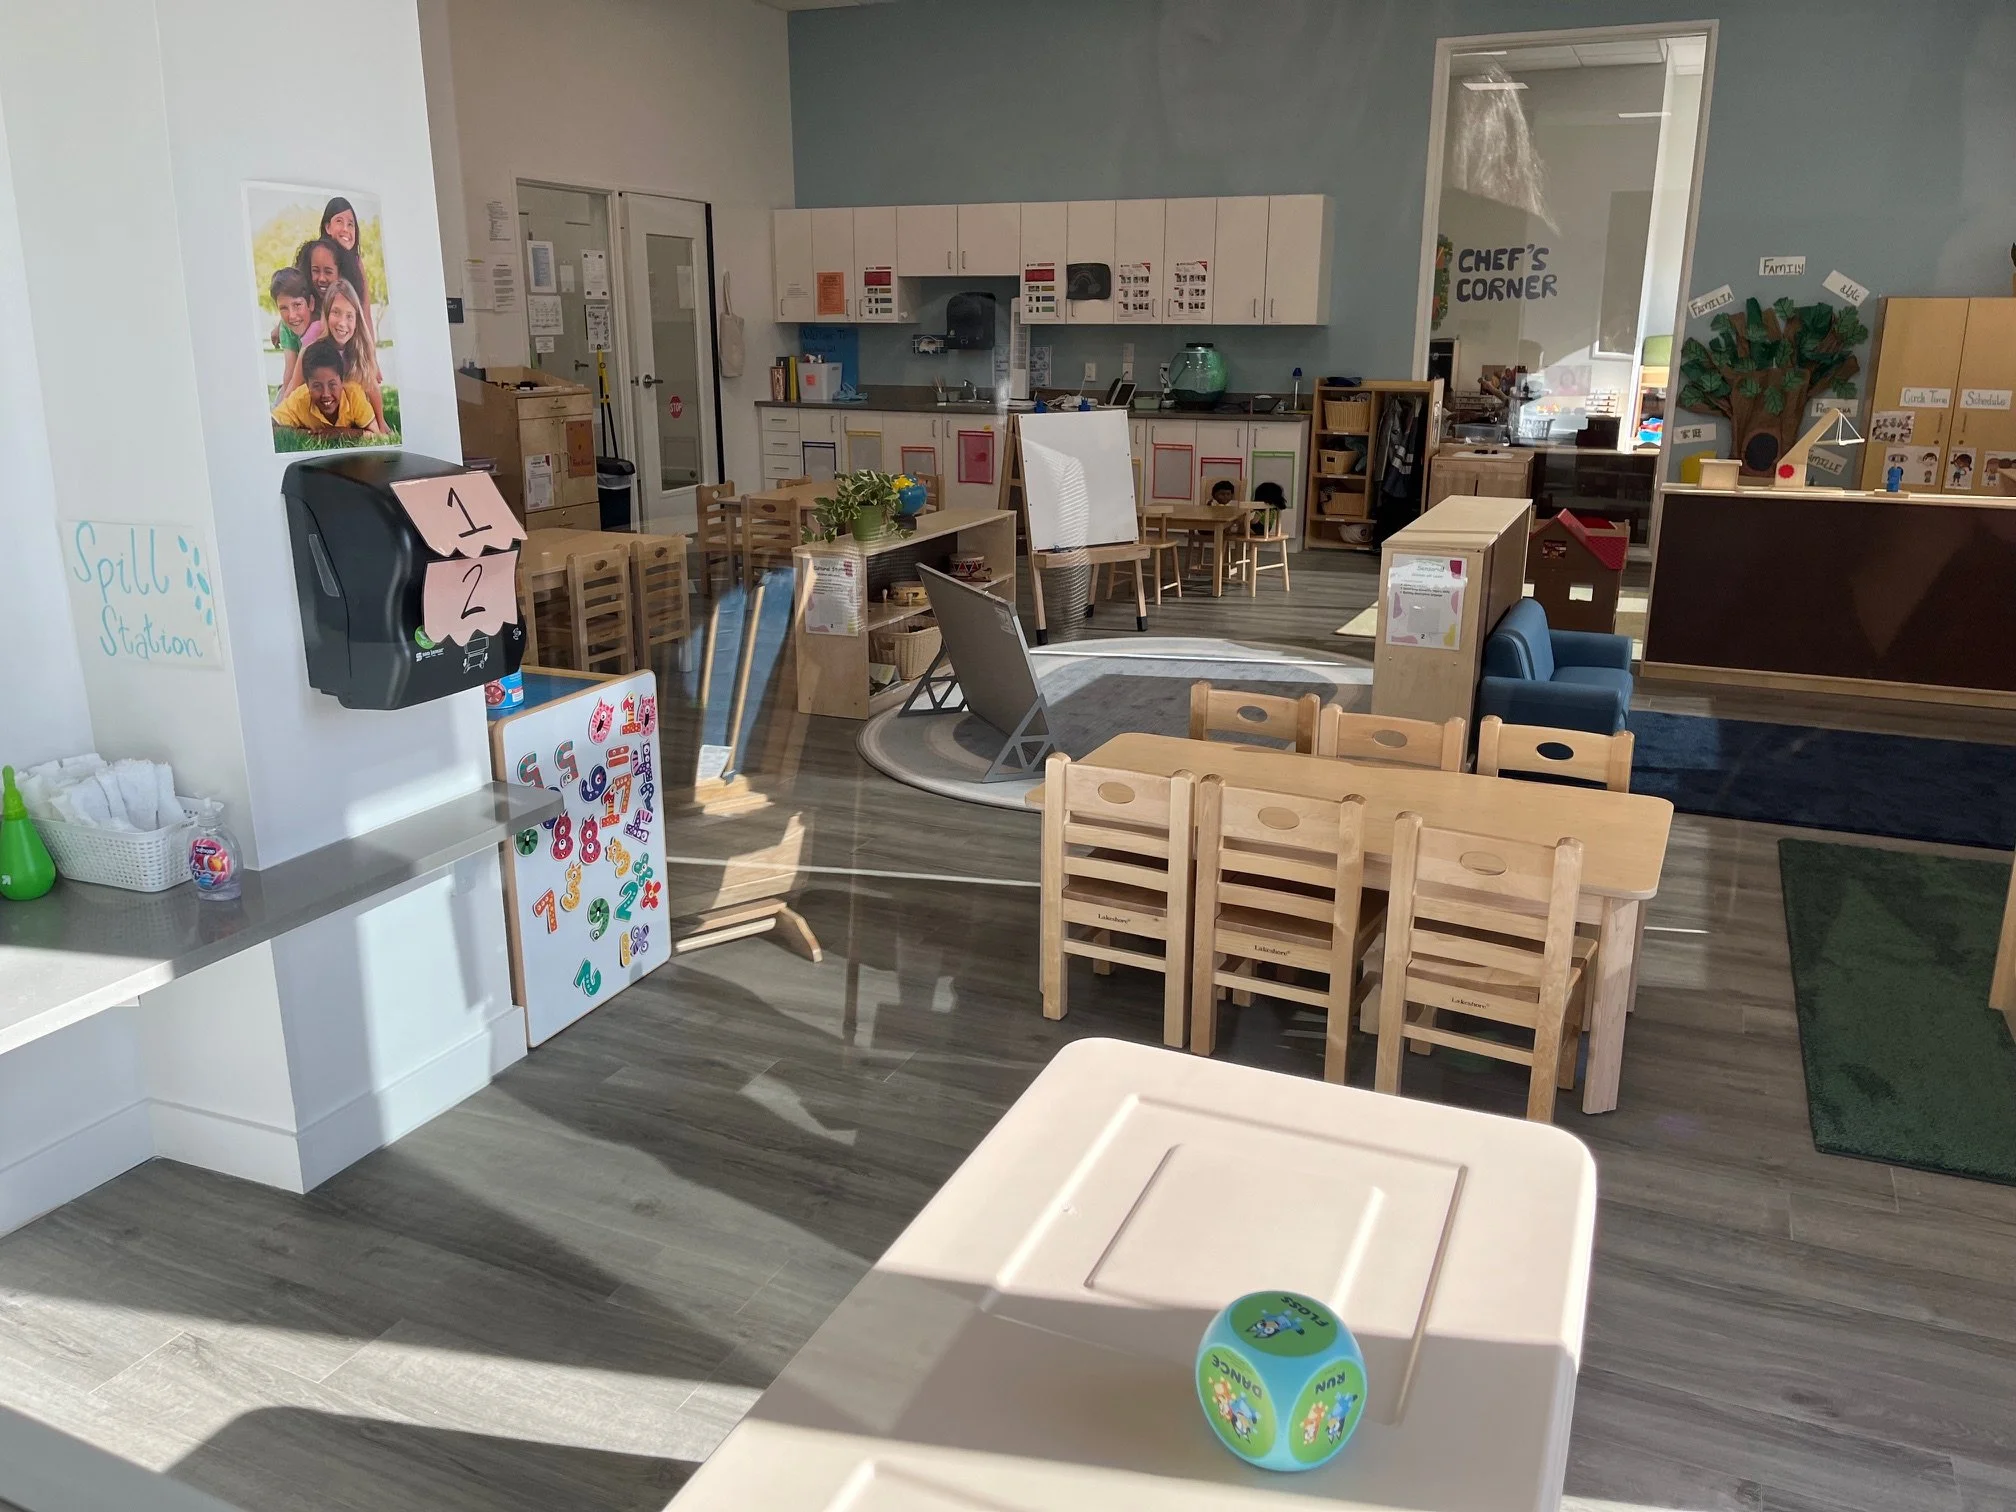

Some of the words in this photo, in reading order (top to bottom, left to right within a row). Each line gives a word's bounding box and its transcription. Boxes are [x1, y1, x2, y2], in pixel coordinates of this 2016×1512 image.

[1458, 243, 1550, 273] CHEF'S
[1456, 274, 1558, 303] CORNER
[1690, 292, 1734, 317] FAMILIA
[670, 402, 682, 413] STOP
[1965, 390, 2006, 406] Schedule
[447, 487, 492, 538] 1
[73, 520, 170, 604] Spill
[461, 564, 486, 620] 2
[100, 604, 203, 661] Station
[551, 809, 574, 861] 8
[579, 814, 602, 864] 8
[561, 861, 582, 912] 3
[614, 880, 639, 921] 2
[587, 897, 610, 941] 9
[1097, 913, 1129, 924] Lakeshore
[1254, 944, 1288, 956] Lakeshore
[1451, 996, 1487, 1009] Lakeshore
[1281, 1296, 1329, 1328] FLOSS
[1211, 1353, 1263, 1398] DANCE
[1315, 1371, 1346, 1395] RUN
